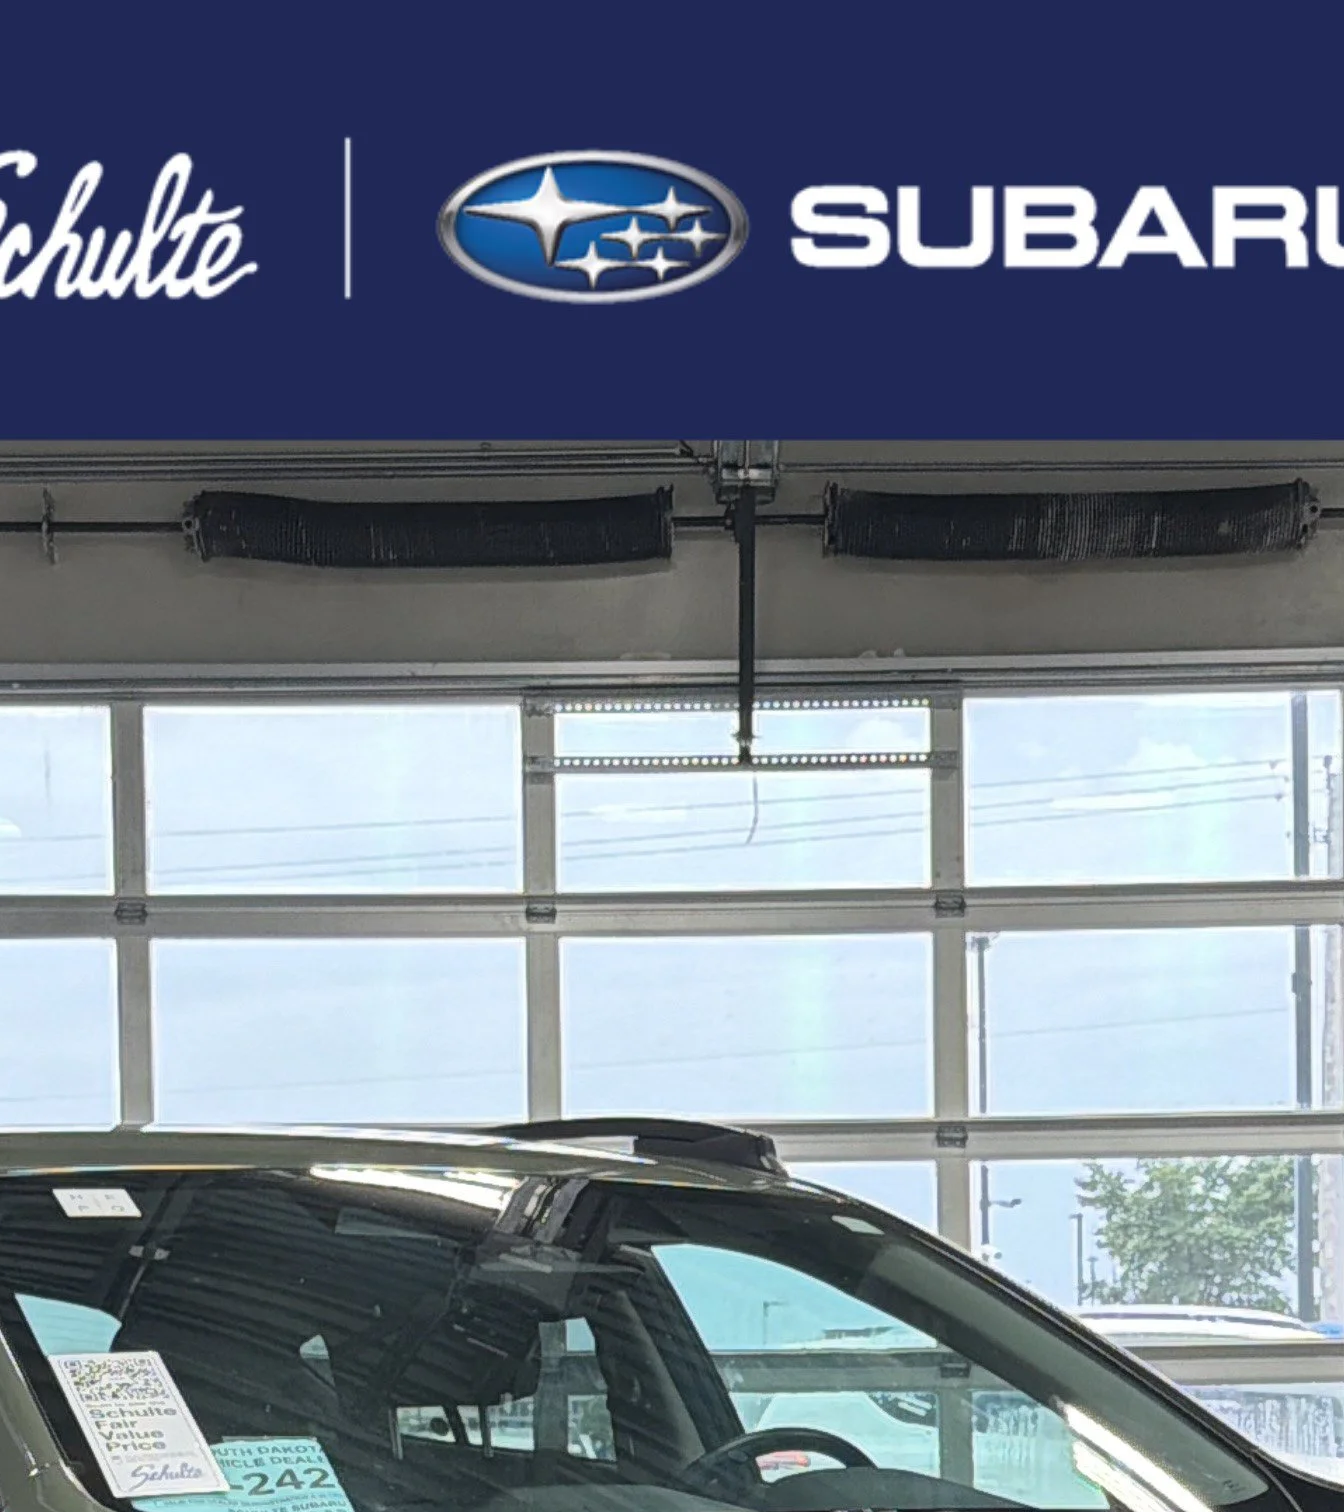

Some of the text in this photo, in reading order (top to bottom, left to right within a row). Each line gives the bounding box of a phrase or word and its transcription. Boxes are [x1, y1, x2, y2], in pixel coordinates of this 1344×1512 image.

[88, 1406, 178, 1419] Schulte
[93, 1419, 138, 1431] Fair
[97, 1430, 165, 1441] Value
[104, 1440, 167, 1453] Price
[129, 1462, 203, 1493] Schulte
